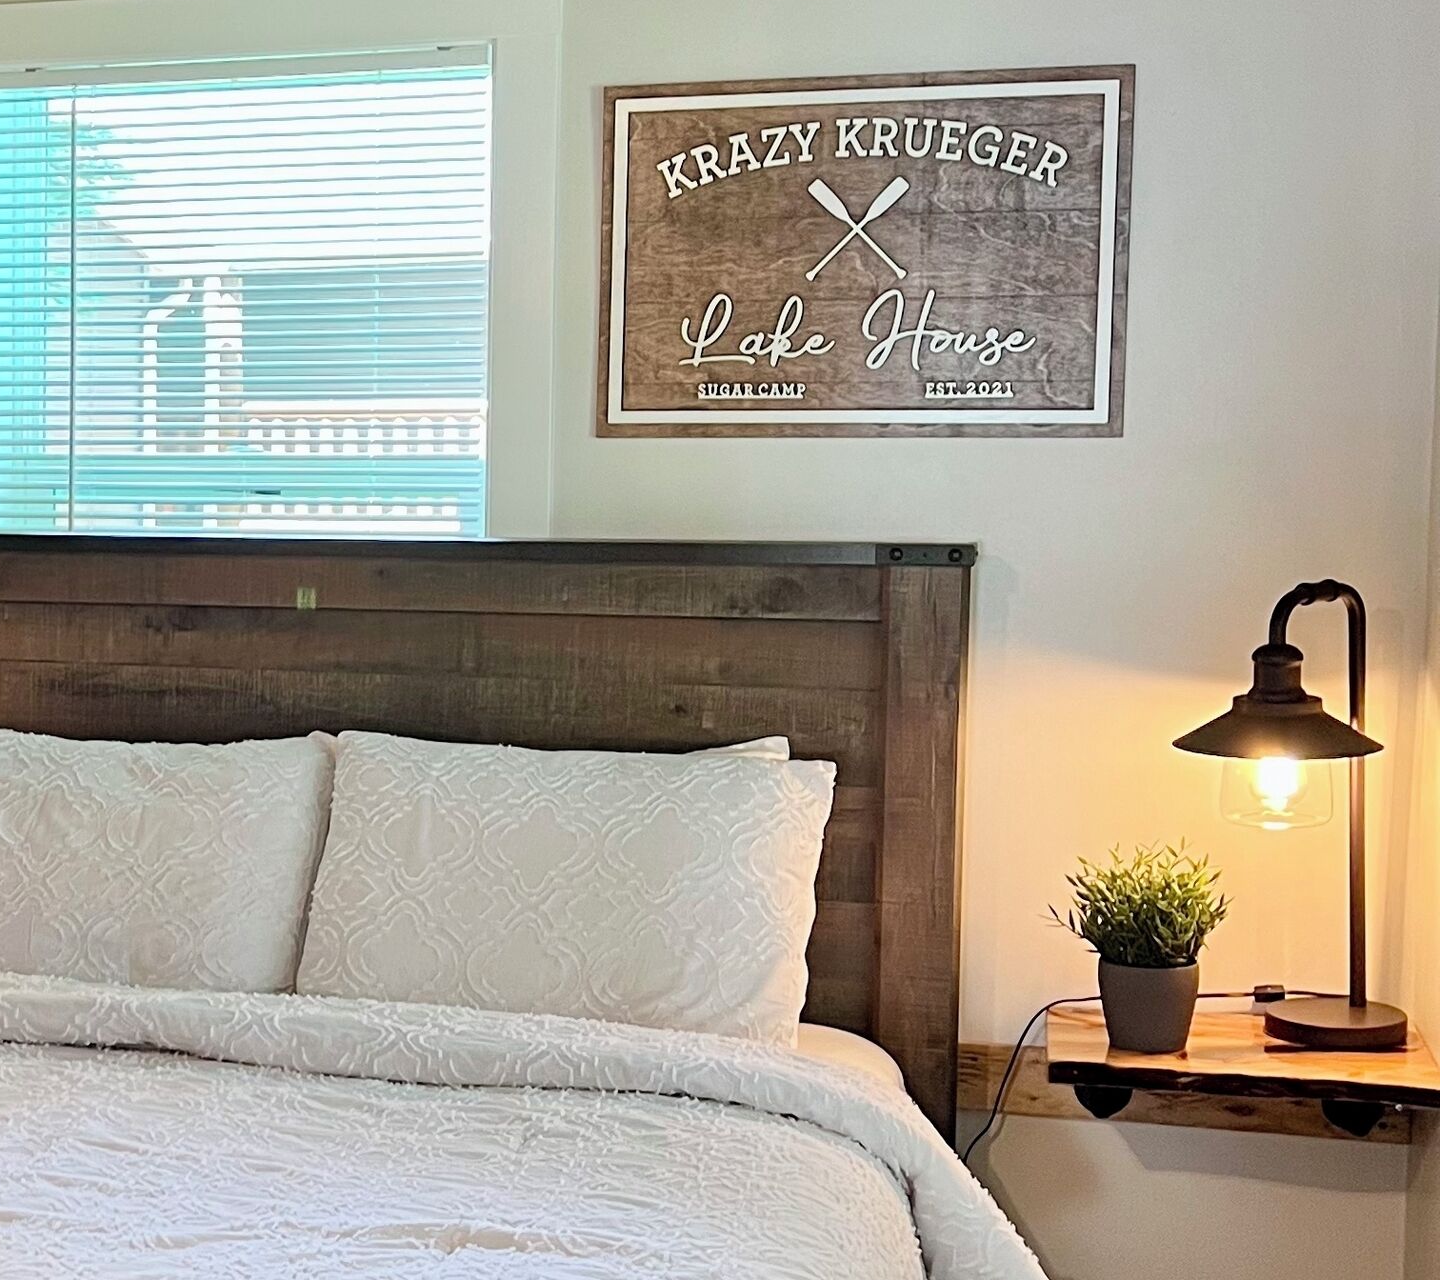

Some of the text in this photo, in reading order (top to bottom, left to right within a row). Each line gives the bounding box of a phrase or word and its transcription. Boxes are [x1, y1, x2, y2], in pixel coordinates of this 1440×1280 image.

[656, 116, 1070, 200] KRAZY KRUEGER
[678, 288, 1037, 372] Lake House
[697, 382, 807, 399] SUGAR CAMP
[924, 381, 1014, 398] EST. 2021
